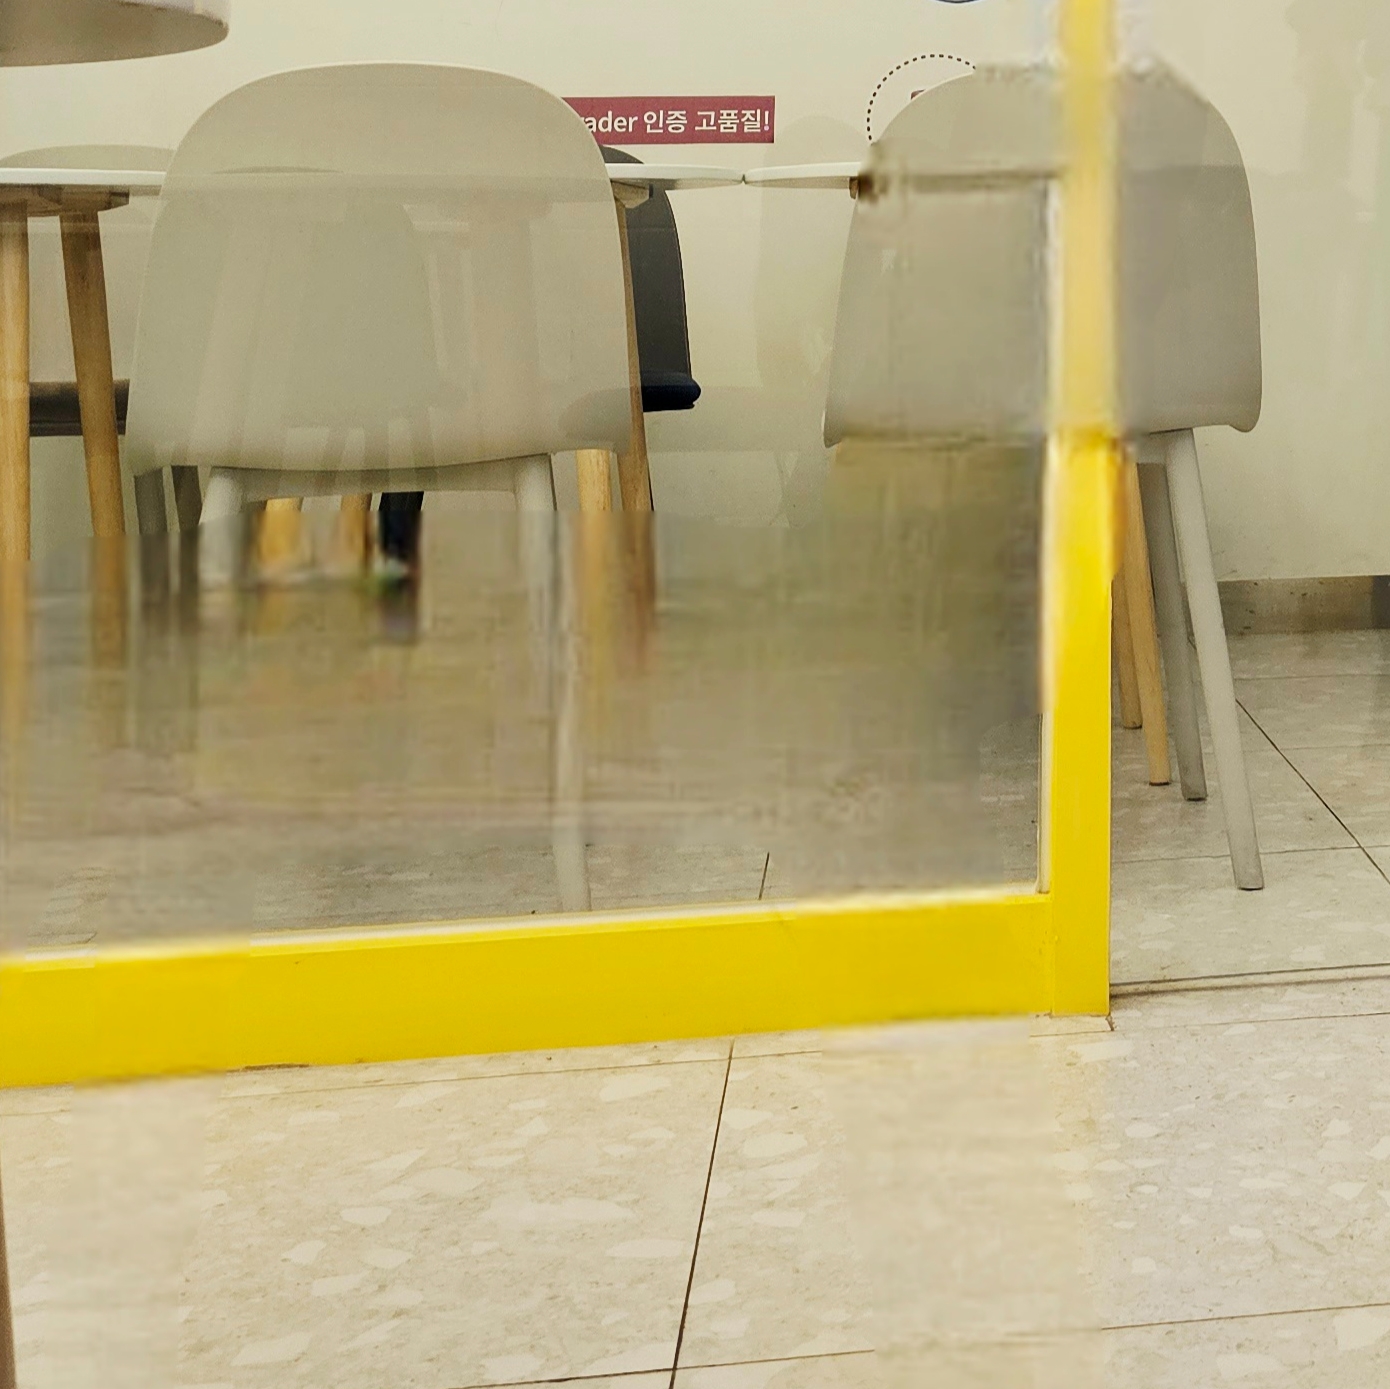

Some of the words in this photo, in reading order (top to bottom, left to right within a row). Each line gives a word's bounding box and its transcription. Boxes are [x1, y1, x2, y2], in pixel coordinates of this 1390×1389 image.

[581, 110, 638, 133] ader
[643, 109, 688, 134] 인증
[694, 109, 770, 134] 고품질!
